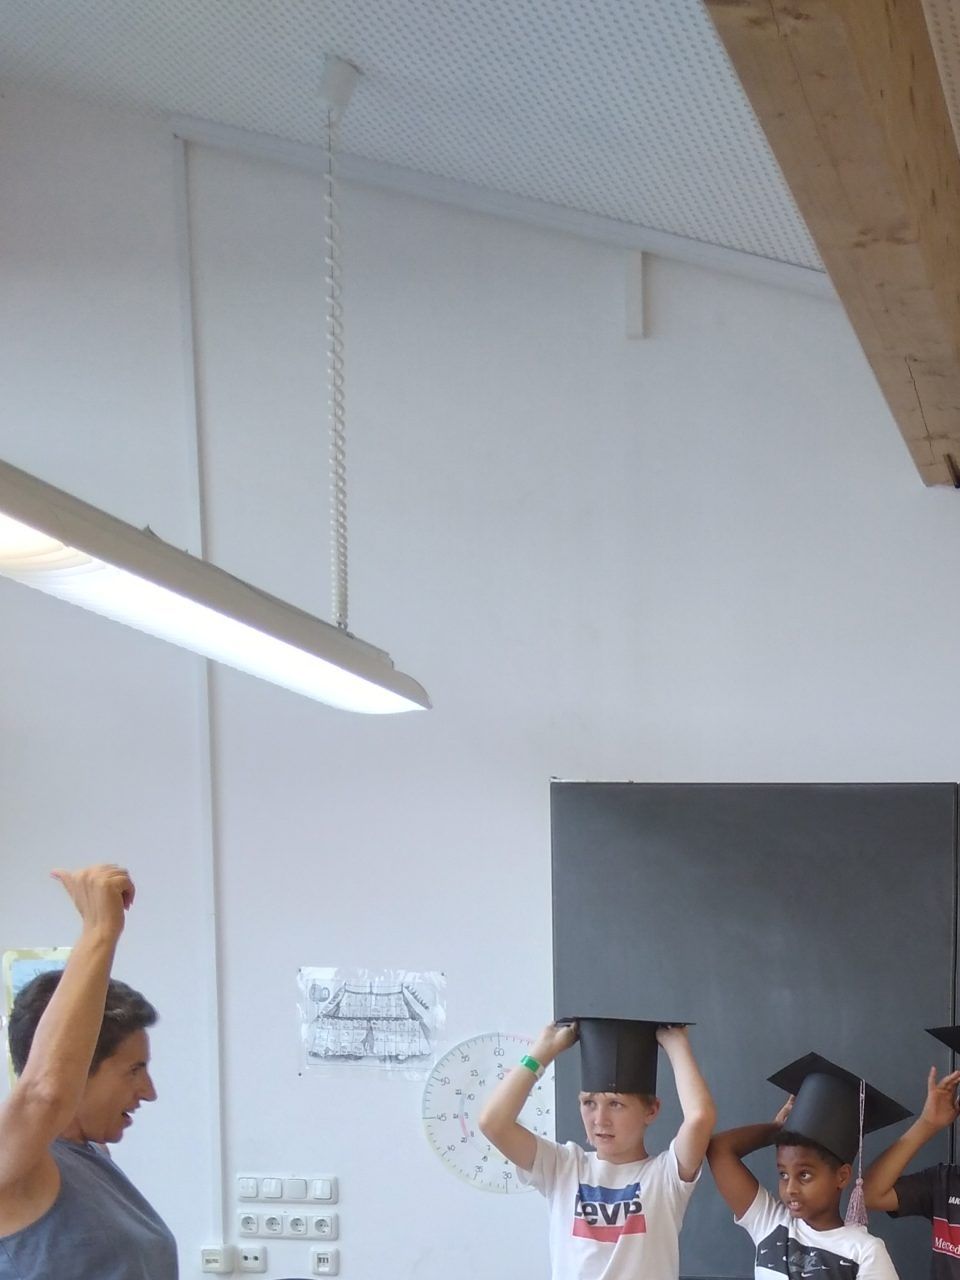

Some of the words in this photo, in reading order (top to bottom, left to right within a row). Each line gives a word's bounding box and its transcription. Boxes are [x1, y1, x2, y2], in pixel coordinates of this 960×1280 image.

[493, 1048, 505, 1057] 60
[440, 1077, 450, 1086] 50
[436, 1113, 447, 1122] 45
[502, 1172, 512, 1180] 30
